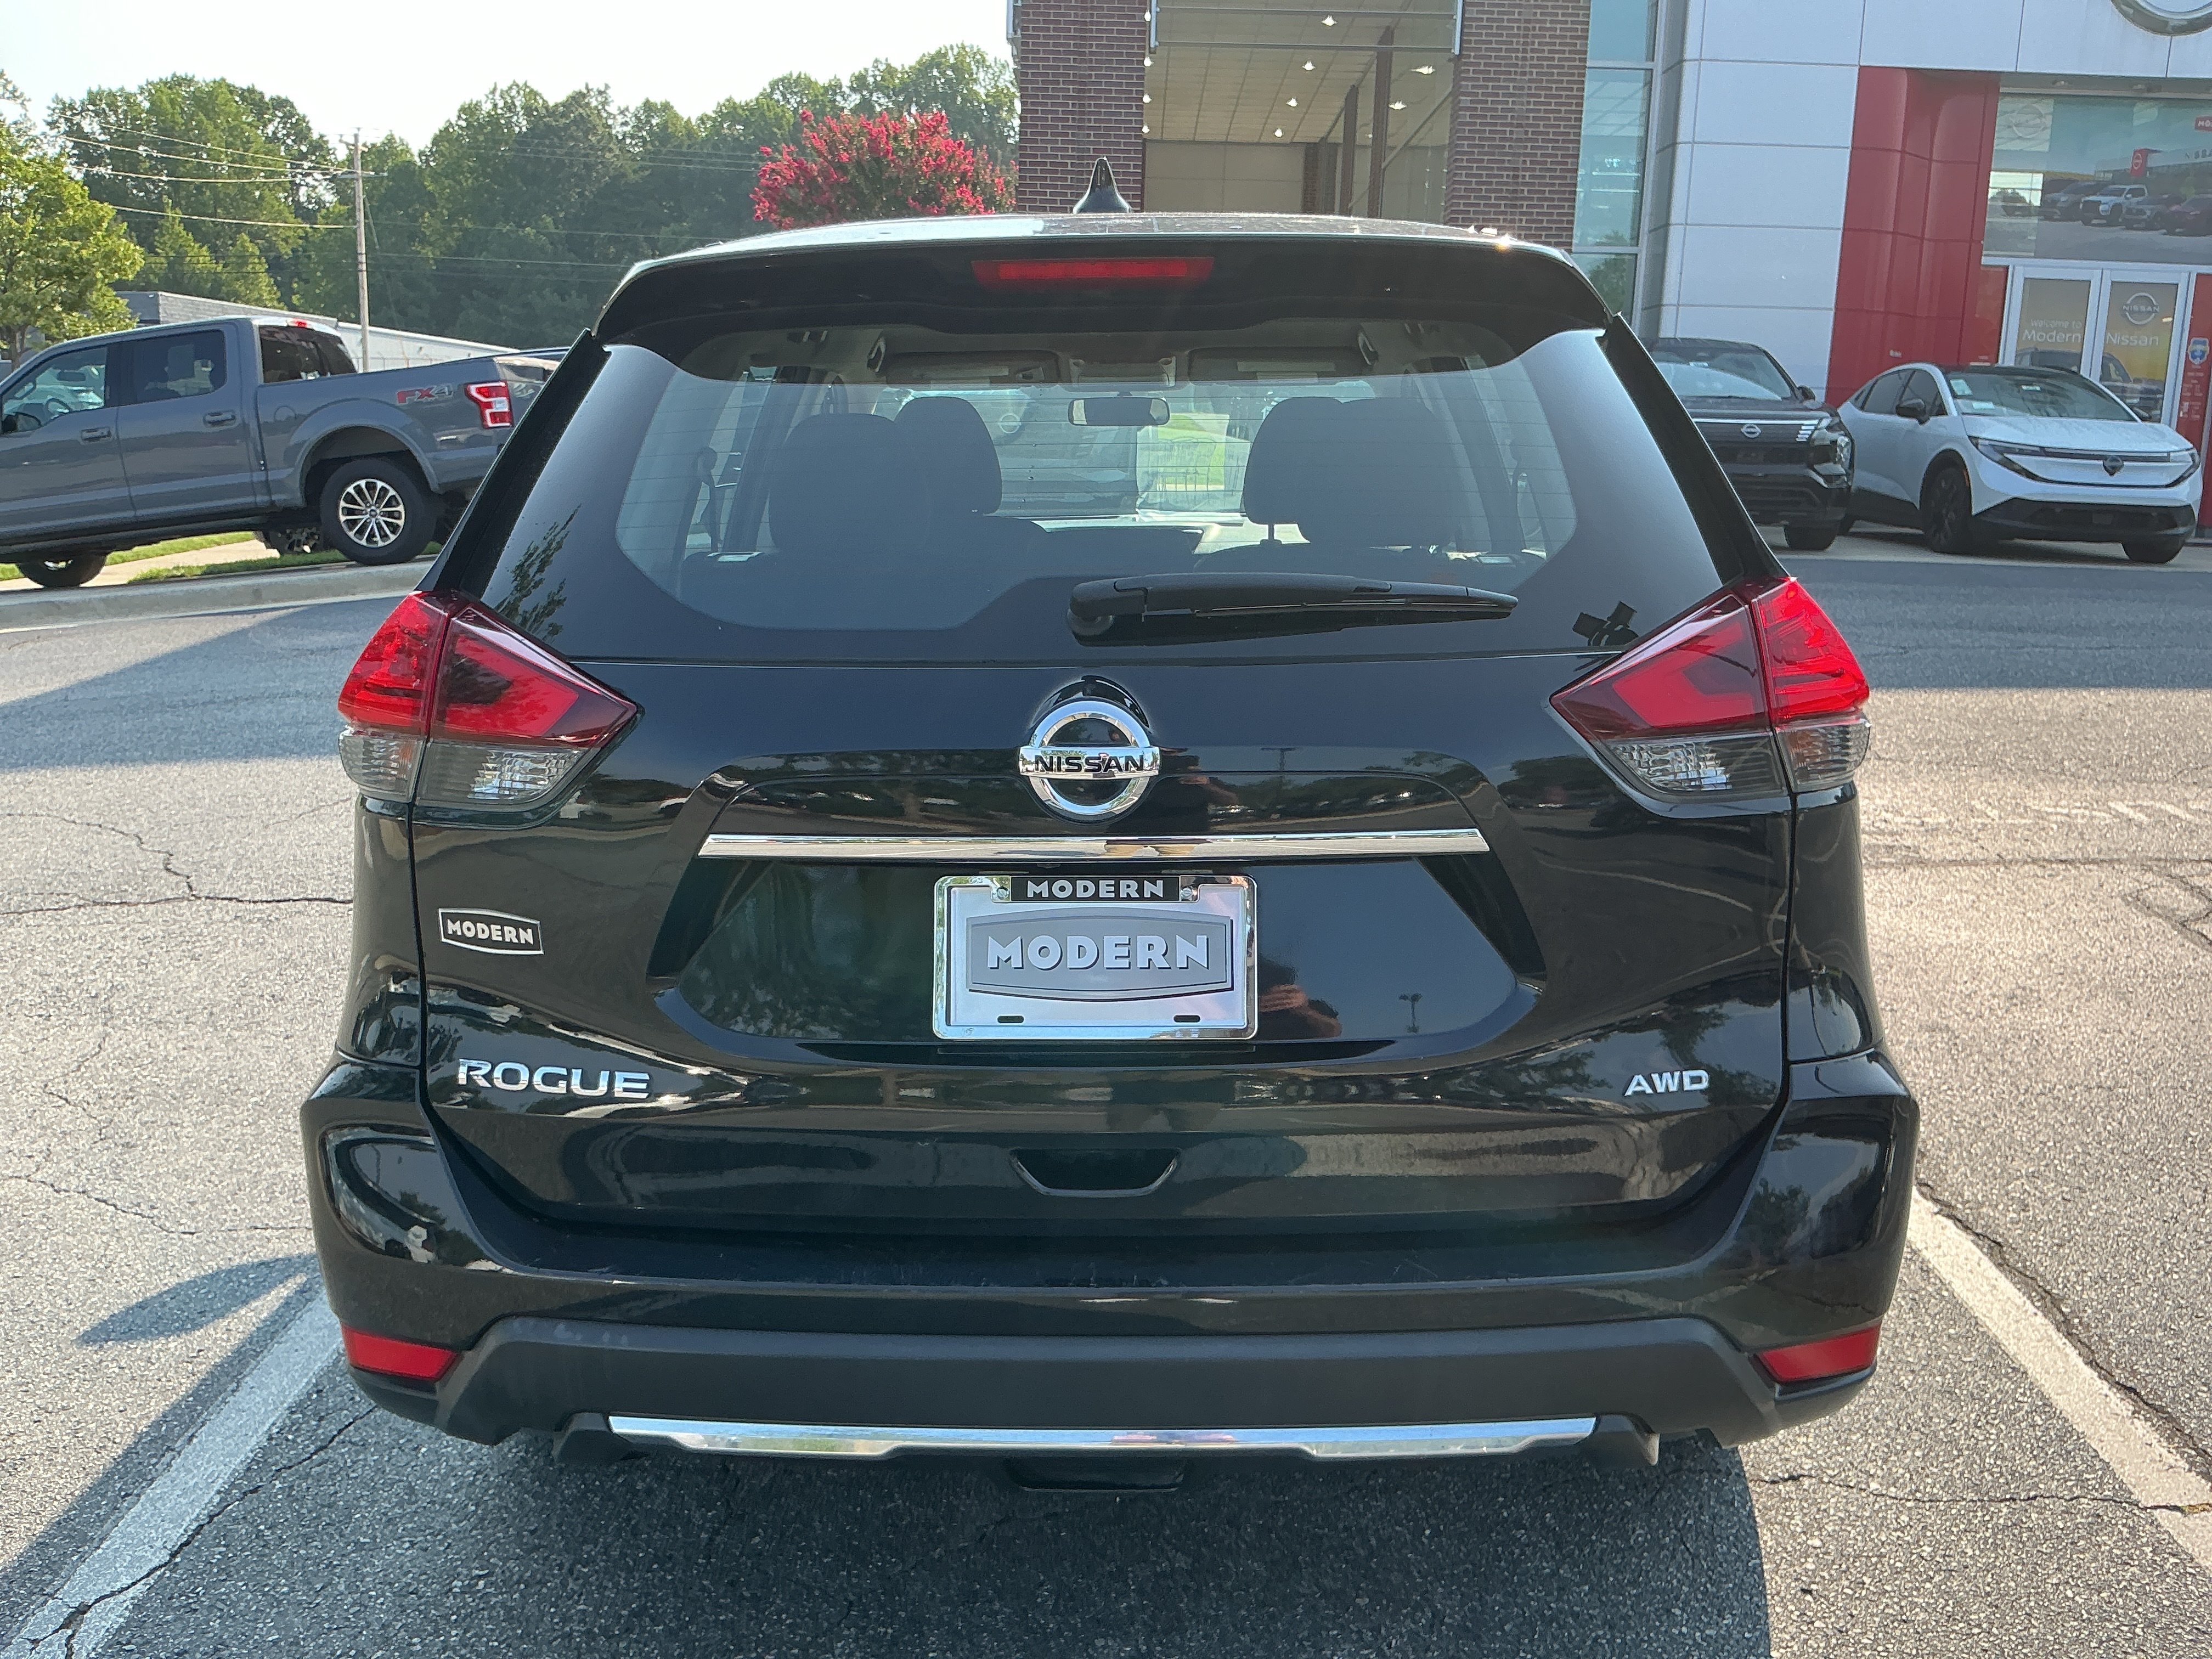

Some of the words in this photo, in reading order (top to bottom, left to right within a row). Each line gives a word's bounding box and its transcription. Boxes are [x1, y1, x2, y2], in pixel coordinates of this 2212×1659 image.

[2023, 330, 2082, 343] Modern
[2106, 332, 2159, 346] Nissan
[397, 384, 453, 404] FX4
[1034, 754, 1144, 773] NISSAN
[1027, 879, 1164, 898] MODERN
[447, 918, 534, 945] MODERN
[988, 935, 1209, 970] MODERN
[457, 1058, 651, 1099] ROGUE
[1624, 1069, 1709, 1097] AWD
